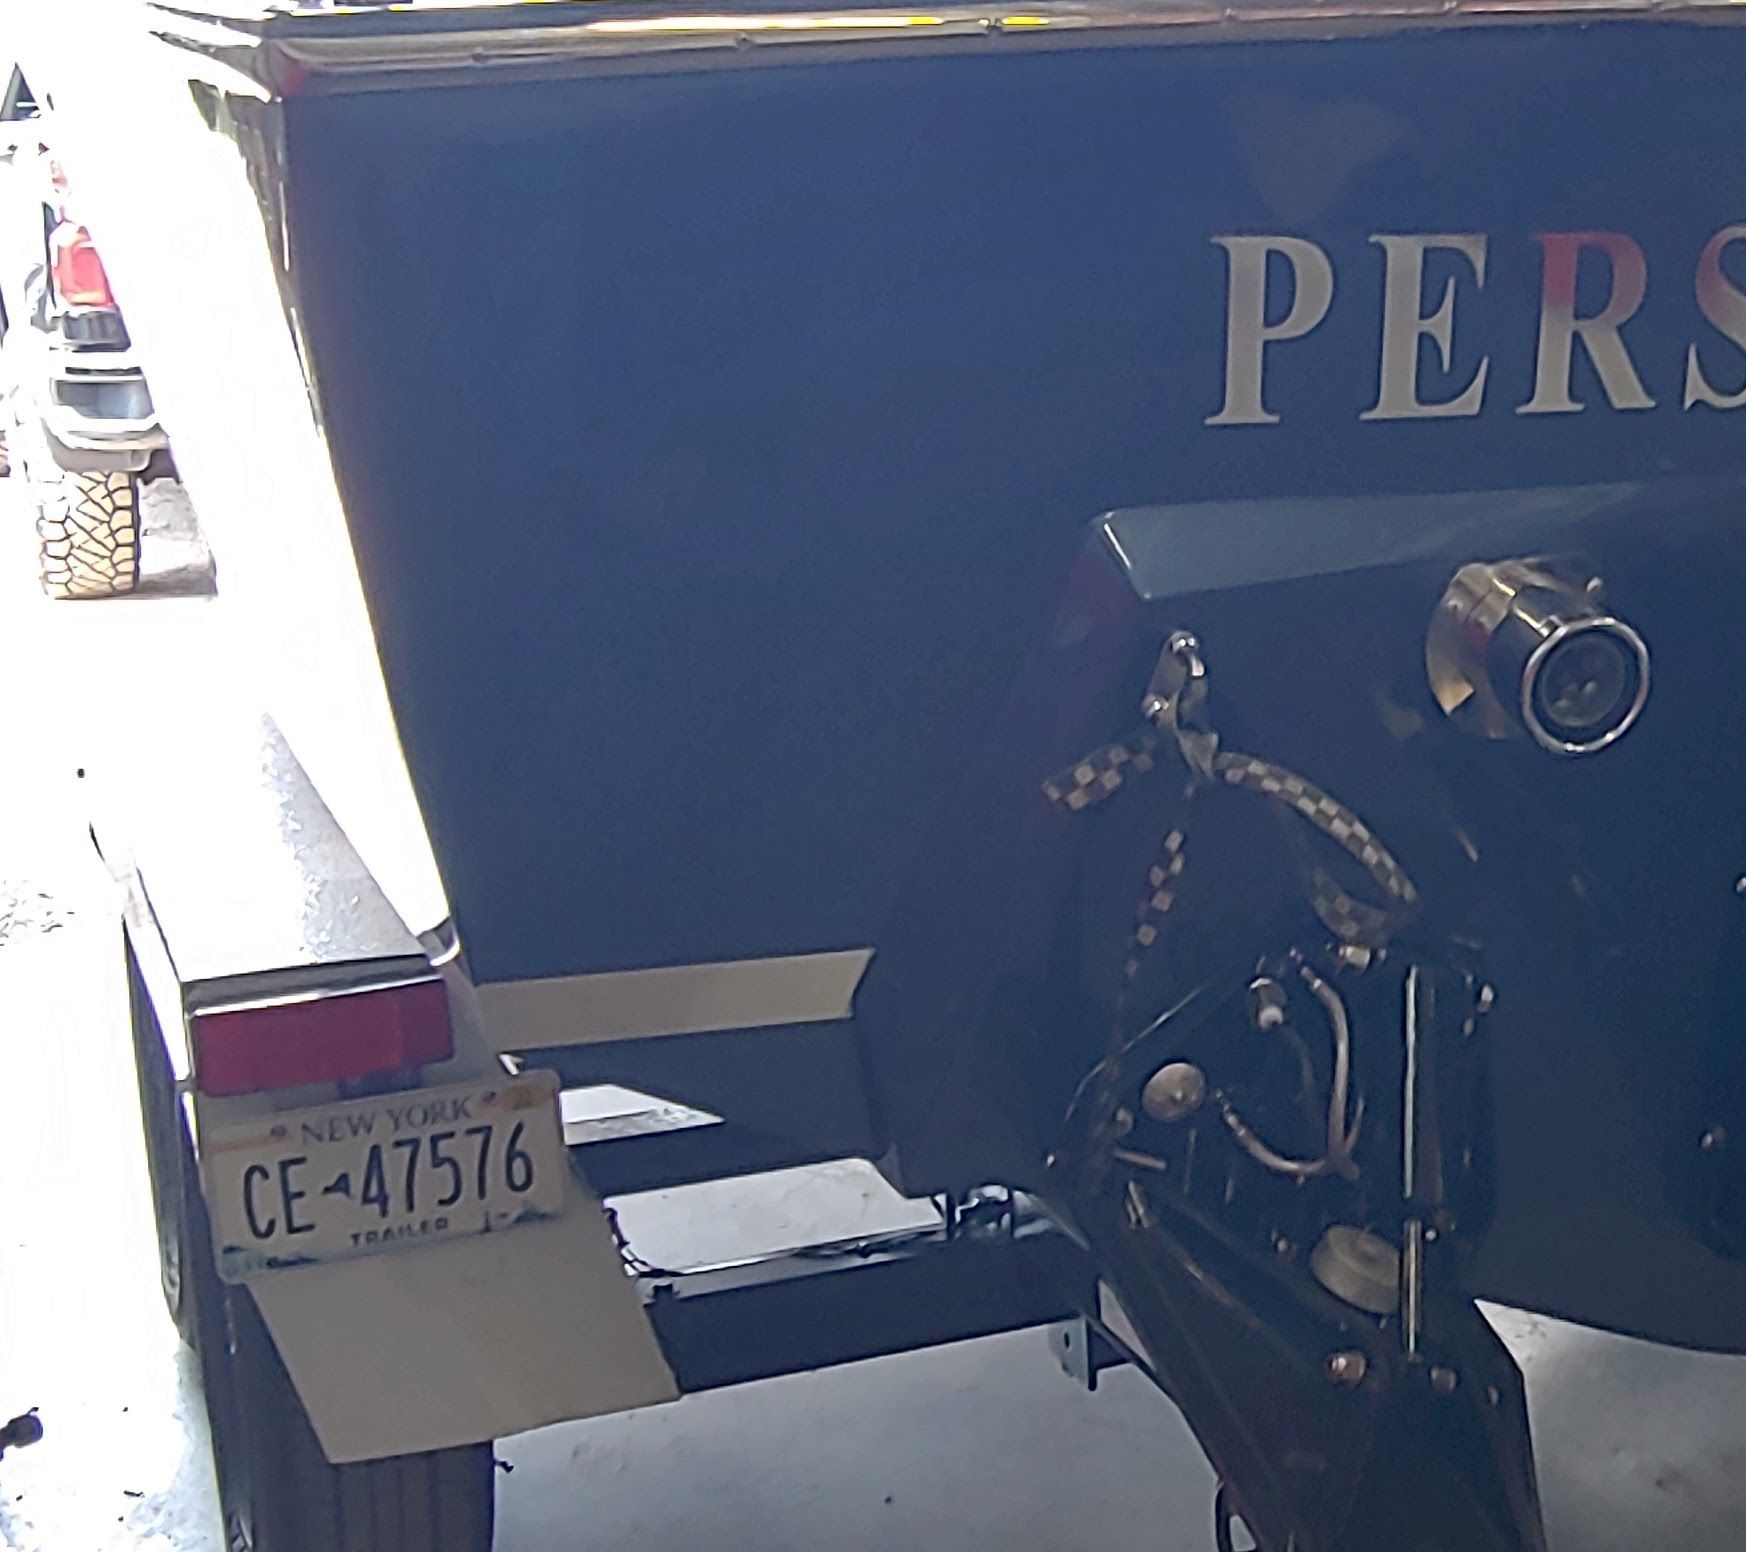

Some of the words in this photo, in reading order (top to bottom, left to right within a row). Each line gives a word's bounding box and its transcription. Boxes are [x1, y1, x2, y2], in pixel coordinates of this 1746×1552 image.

[301, 1112, 378, 1147] NEW
[388, 1094, 473, 1132] YORK
[243, 1156, 317, 1240] CE
[361, 1121, 535, 1219] 47576
[350, 1216, 450, 1248] TRAILER
